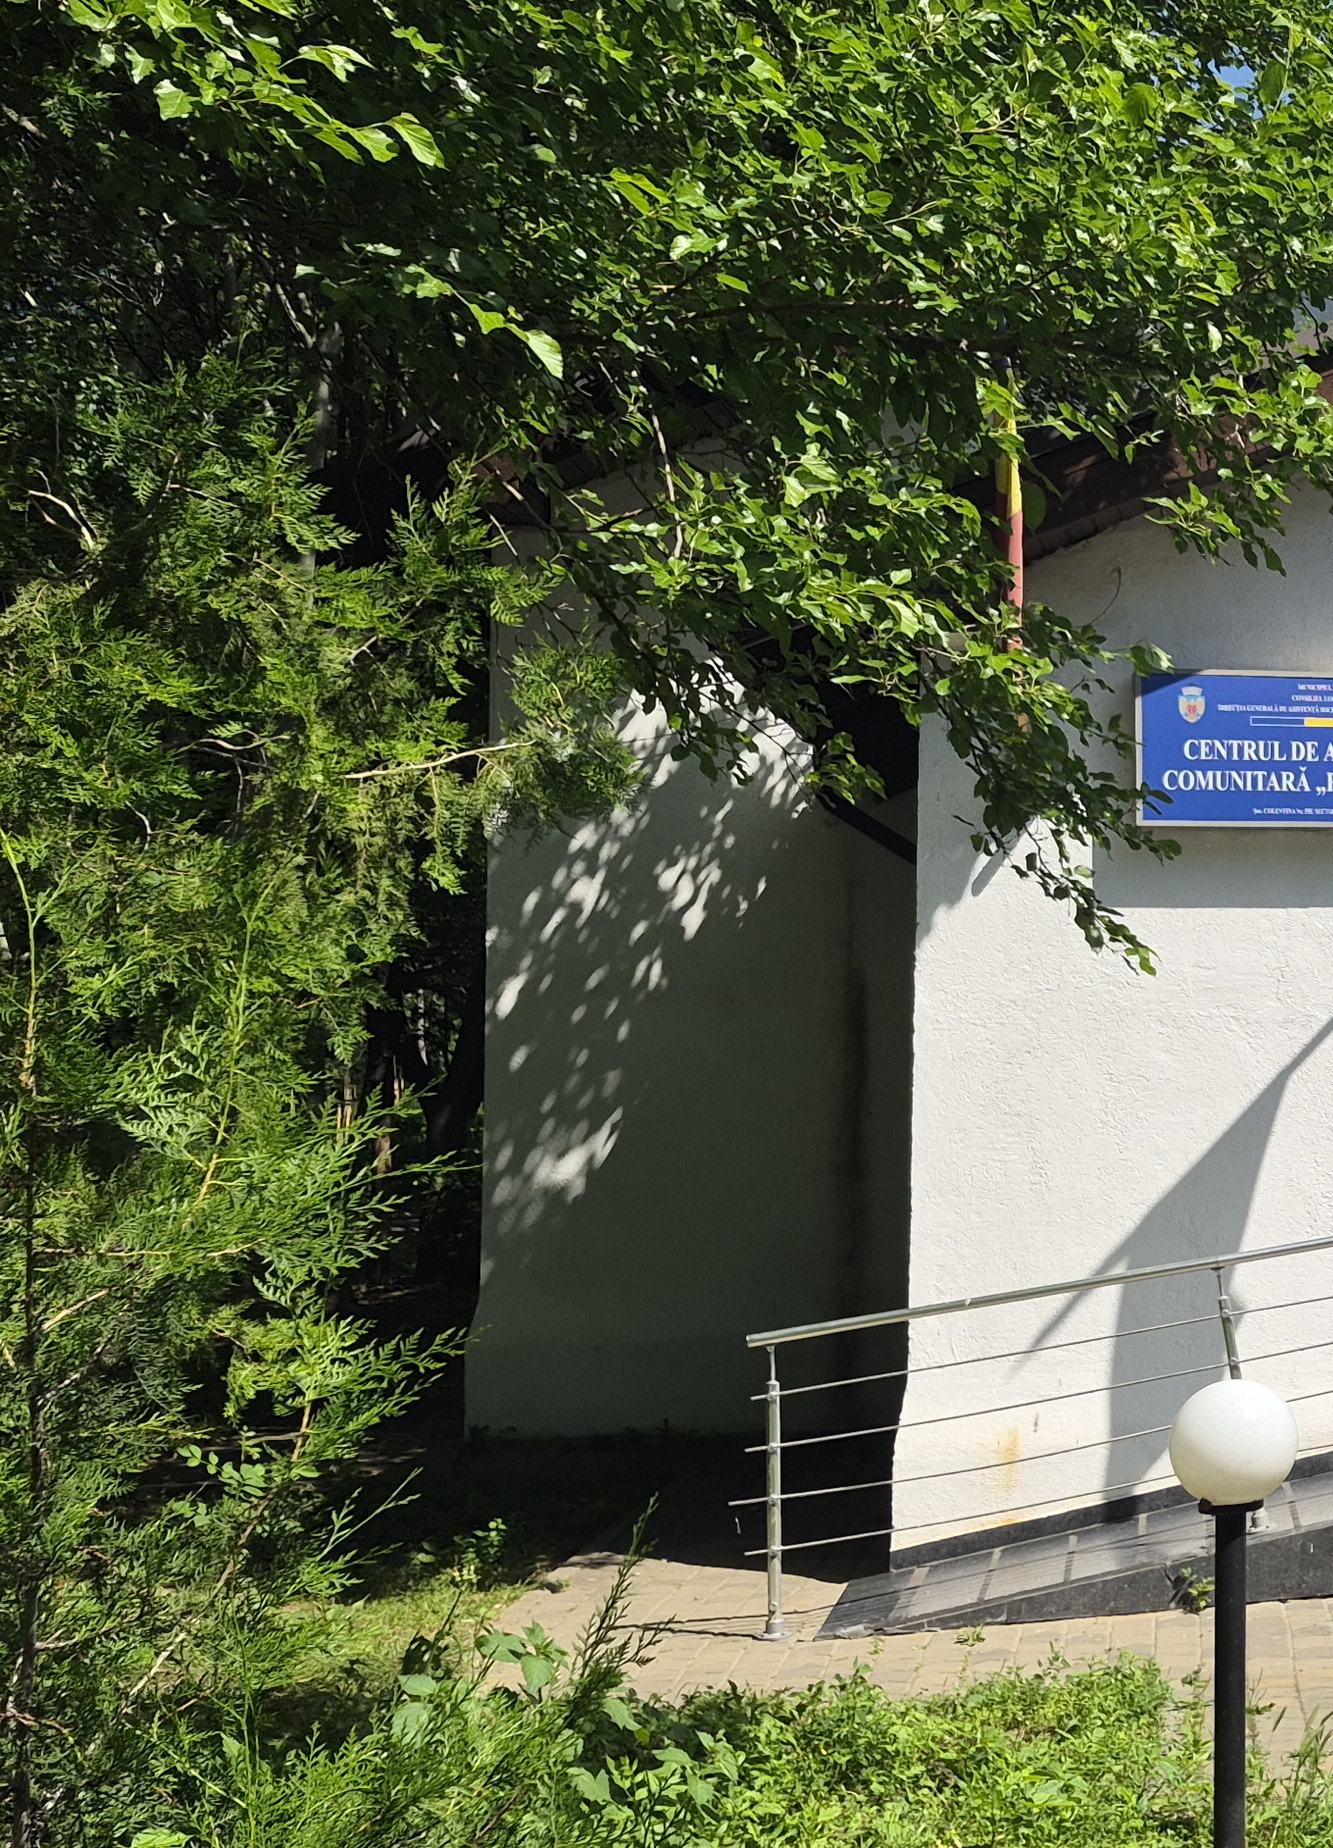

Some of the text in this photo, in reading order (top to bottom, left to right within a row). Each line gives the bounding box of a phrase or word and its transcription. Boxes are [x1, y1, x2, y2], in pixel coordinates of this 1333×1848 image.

[1183, 739, 1287, 761] CENTRUL
[1290, 741, 1319, 762] DE
[1162, 766, 1310, 792] COMUNITARĂ
